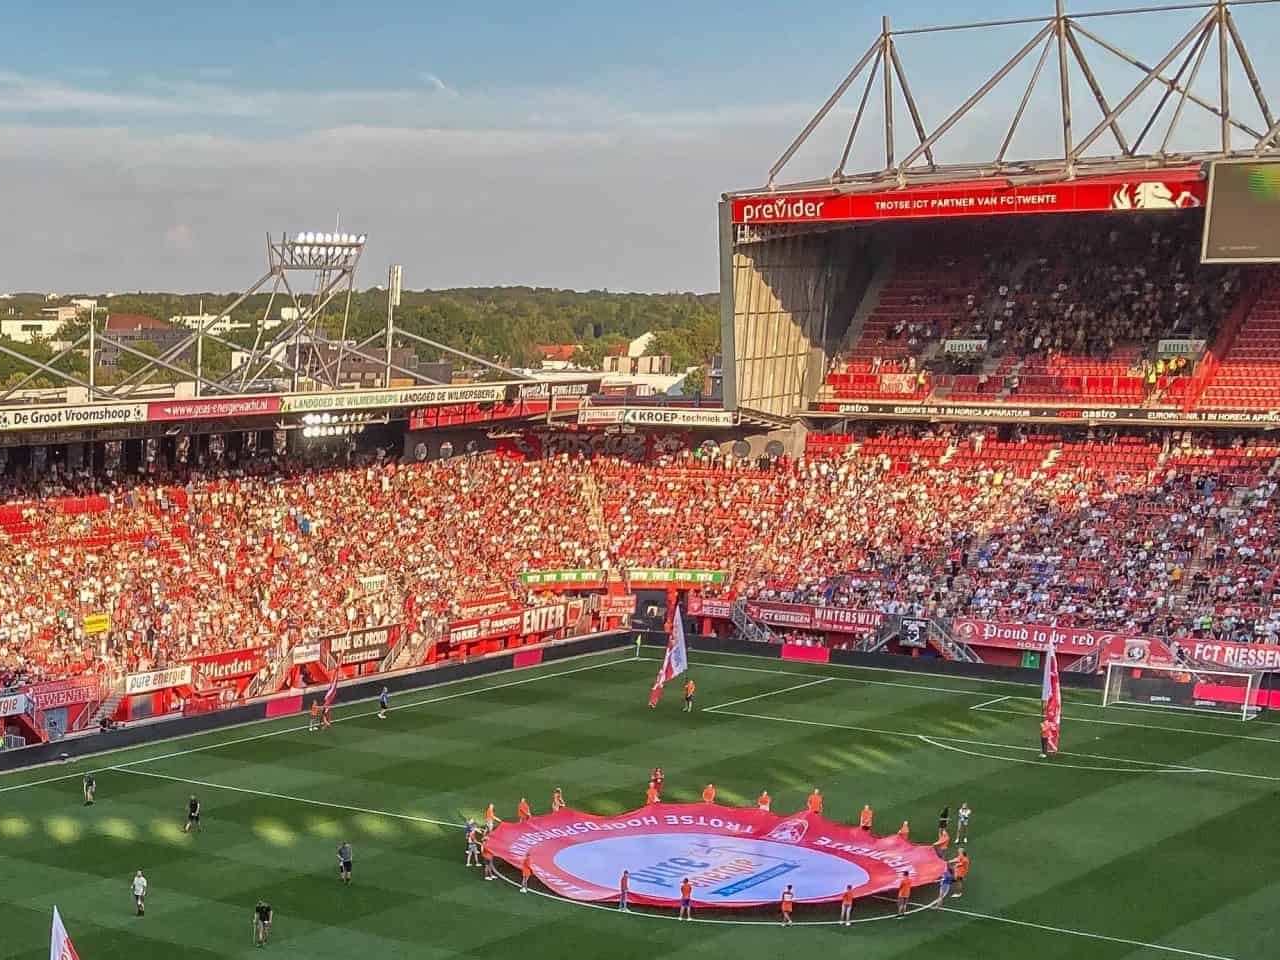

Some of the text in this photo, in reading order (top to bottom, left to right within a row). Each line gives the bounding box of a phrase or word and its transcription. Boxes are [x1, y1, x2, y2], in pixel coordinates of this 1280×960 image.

[743, 199, 824, 221] previder
[875, 193, 1057, 210] TROTSE ICT PARTNER VAN FC TWENTE
[14, 407, 131, 424] De Groot Vroomshoop
[523, 605, 565, 634] ENTER
[815, 608, 881, 627] WINTERSWIJK
[983, 623, 1028, 642] Proud
[1032, 627, 1046, 643] to
[1072, 632, 1094, 647] red
[1194, 641, 1221, 661] FCT
[130, 668, 186, 692] pure energie
[665, 814, 754, 834] TROTSE
